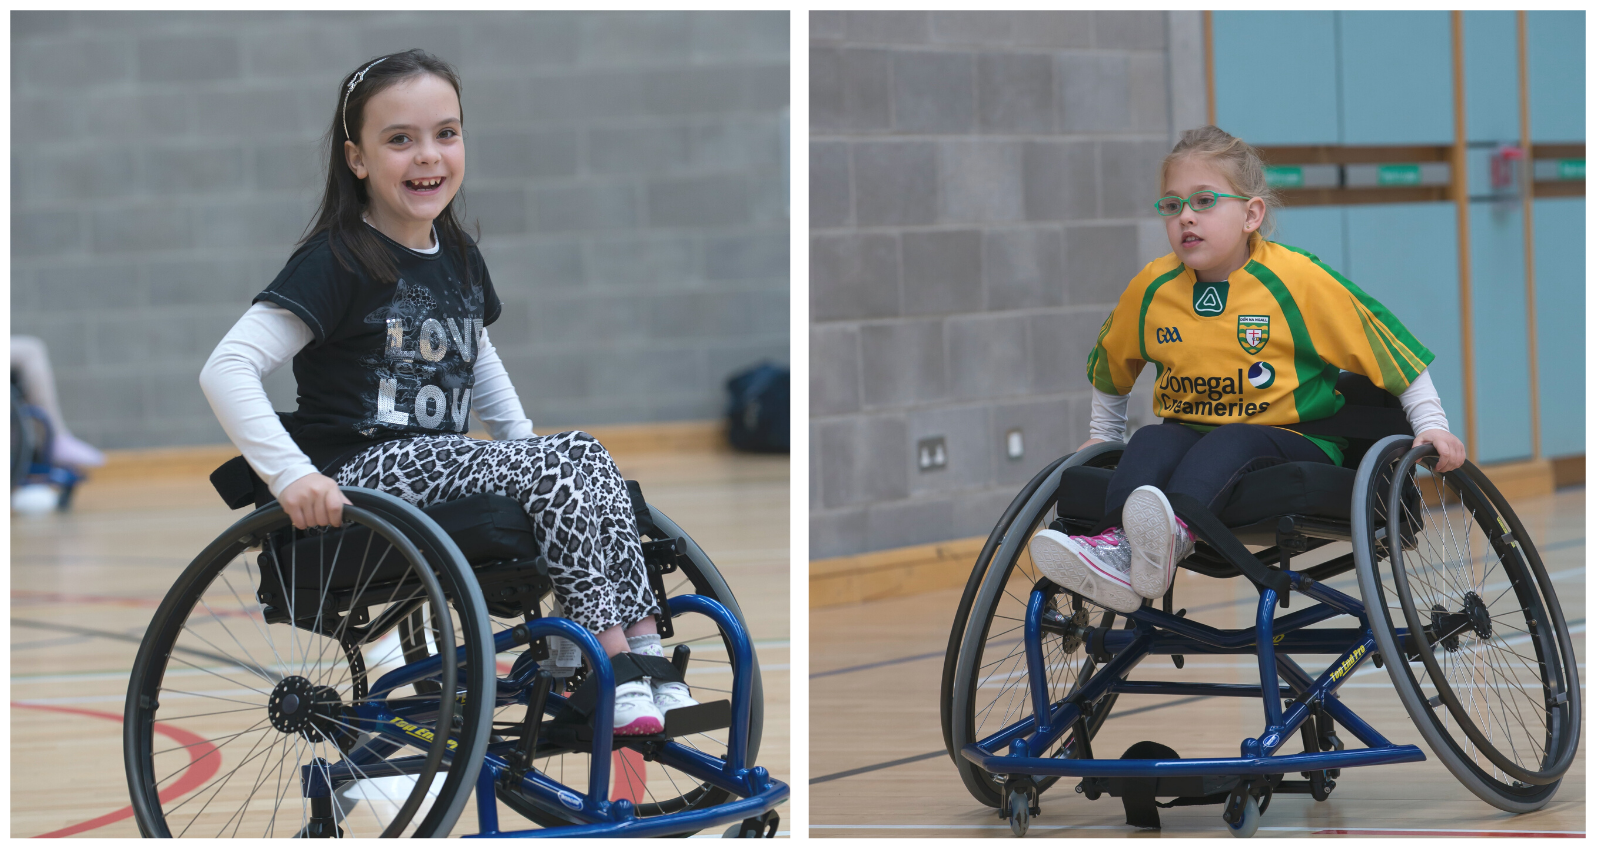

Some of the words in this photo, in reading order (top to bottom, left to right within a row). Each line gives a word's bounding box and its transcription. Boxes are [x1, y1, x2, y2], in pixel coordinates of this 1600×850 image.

[1159, 367, 1243, 401] Donegal
[377, 378, 473, 433] LOV
[1161, 393, 1270, 417] Creameries
[1329, 666, 1344, 682] Top
[1341, 653, 1356, 671] End
[1352, 644, 1366, 660] Pro
[389, 716, 418, 732] Top
[414, 727, 435, 741] En
